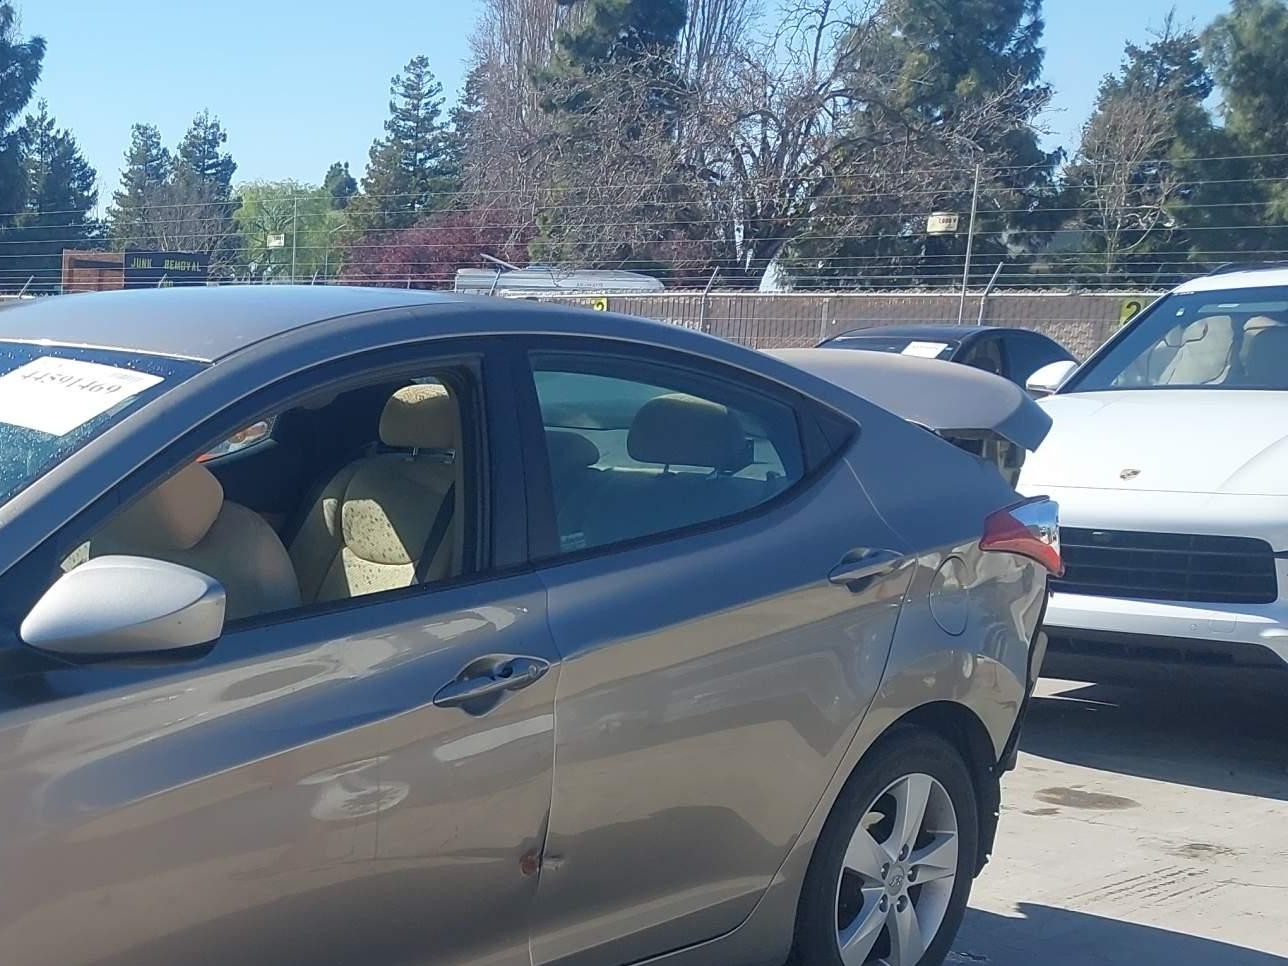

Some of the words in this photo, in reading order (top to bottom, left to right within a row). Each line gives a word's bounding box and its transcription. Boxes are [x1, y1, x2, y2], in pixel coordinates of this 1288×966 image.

[130, 257, 152, 270] JUNK
[164, 259, 202, 273] REMOVAL
[22, 370, 123, 394] 44591469
